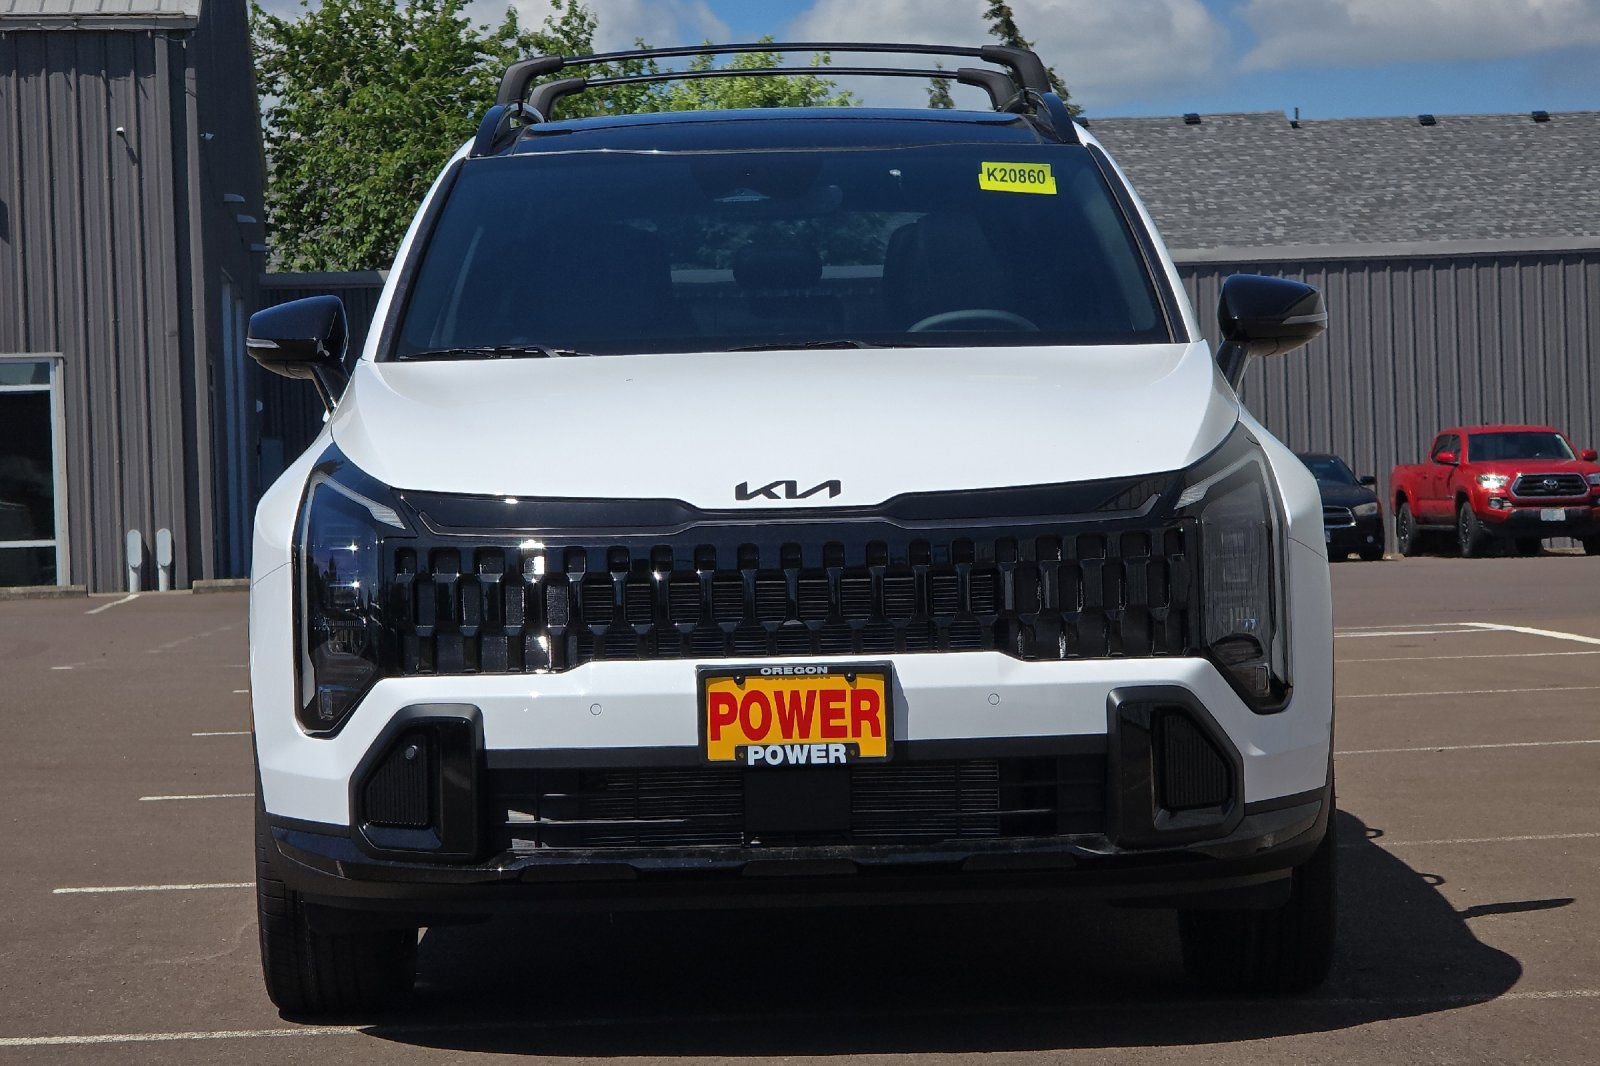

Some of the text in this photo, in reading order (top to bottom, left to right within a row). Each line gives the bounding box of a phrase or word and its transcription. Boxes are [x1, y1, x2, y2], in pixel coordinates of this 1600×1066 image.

[987, 168, 1046, 184] K20860
[735, 480, 841, 501] KIA
[760, 666, 828, 675] OREGON
[710, 689, 881, 741] POWER
[747, 743, 847, 765] POWER
